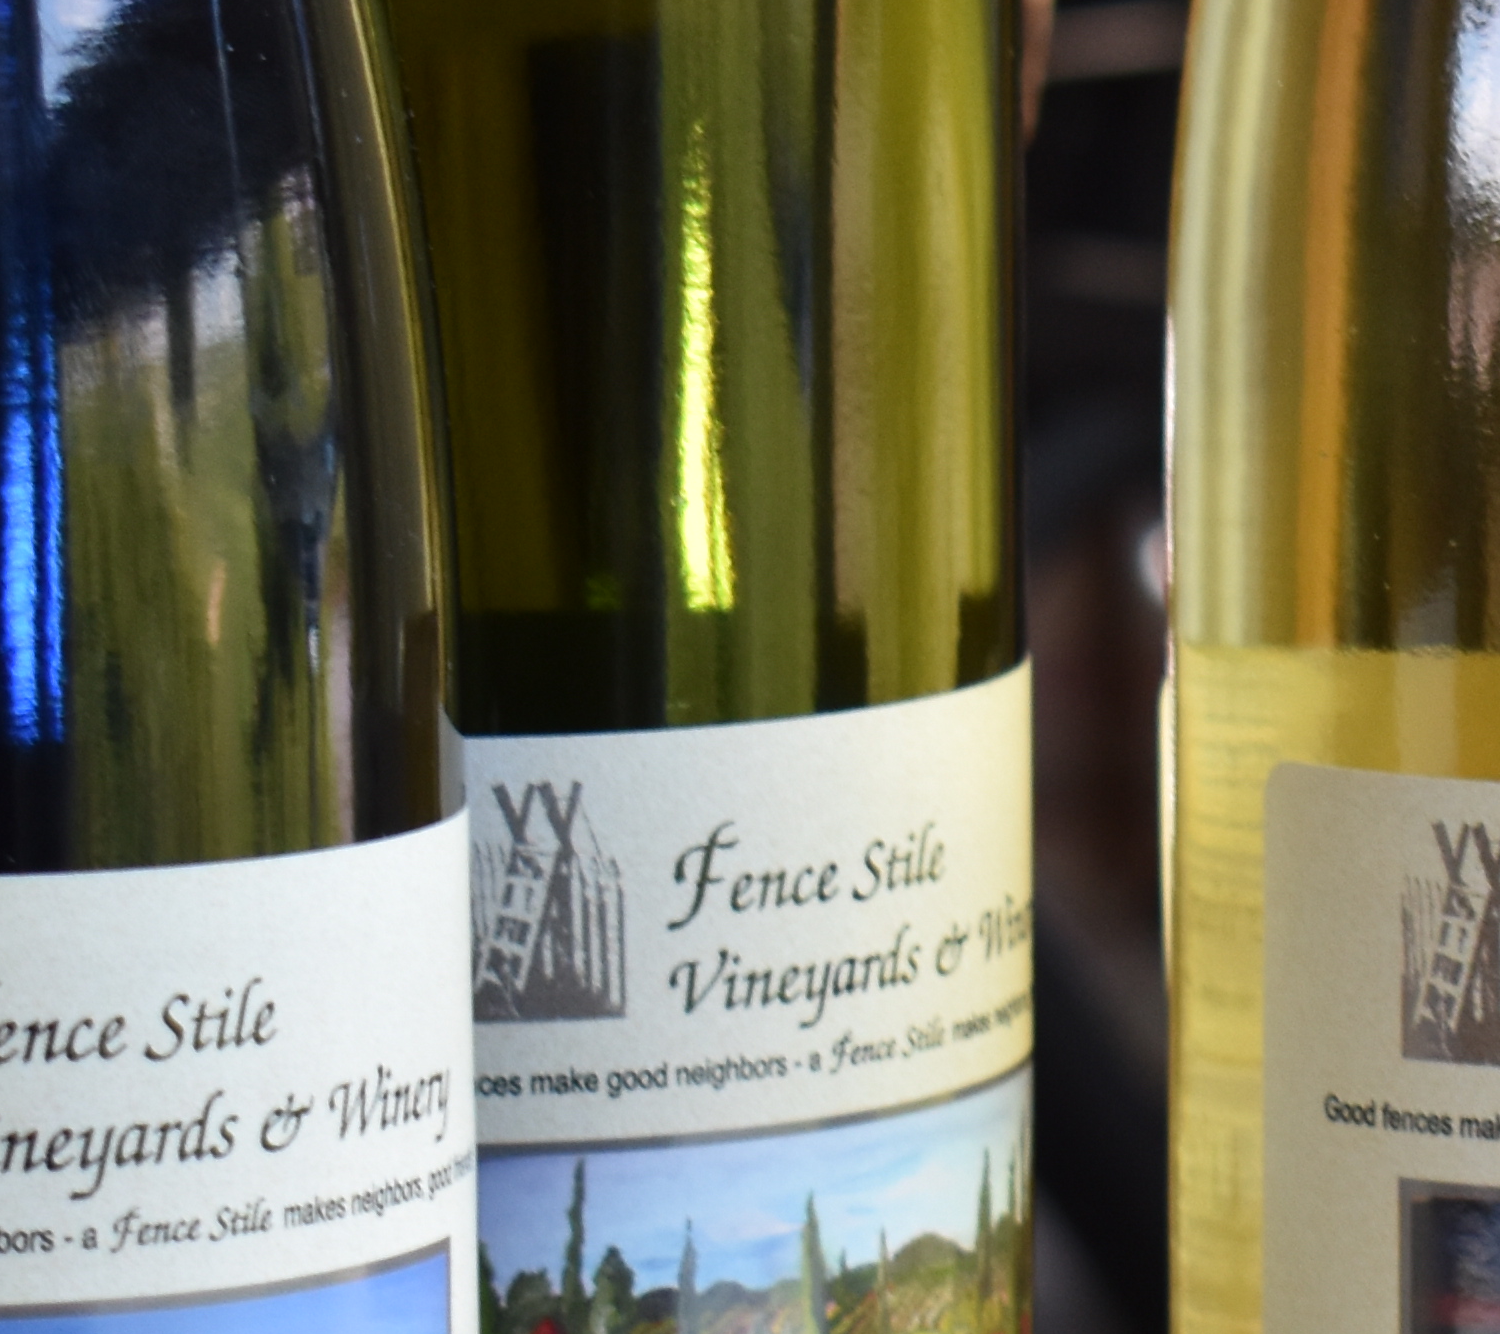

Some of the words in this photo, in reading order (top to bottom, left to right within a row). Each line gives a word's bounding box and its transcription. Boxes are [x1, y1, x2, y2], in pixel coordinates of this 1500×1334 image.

[666, 820, 840, 930] Fence
[851, 821, 947, 901] Stile
[143, 975, 279, 1063] Stile
[668, 924, 920, 1030] Vineyards
[935, 922, 971, 977] &
[475, 1072, 523, 1098] ces
[530, 1065, 600, 1095] make
[606, 1060, 670, 1100] good
[675, 1051, 788, 1092] neighbors
[828, 1028, 897, 1075] Fence
[258, 1091, 314, 1153] &
[328, 1064, 453, 1143] Winery
[1323, 1092, 1377, 1127] Good
[1382, 1103, 1453, 1137] fences
[81, 1231, 98, 1251] a
[109, 1206, 202, 1254] Fence
[208, 1195, 272, 1242] Stile
[283, 1195, 347, 1228] makes
